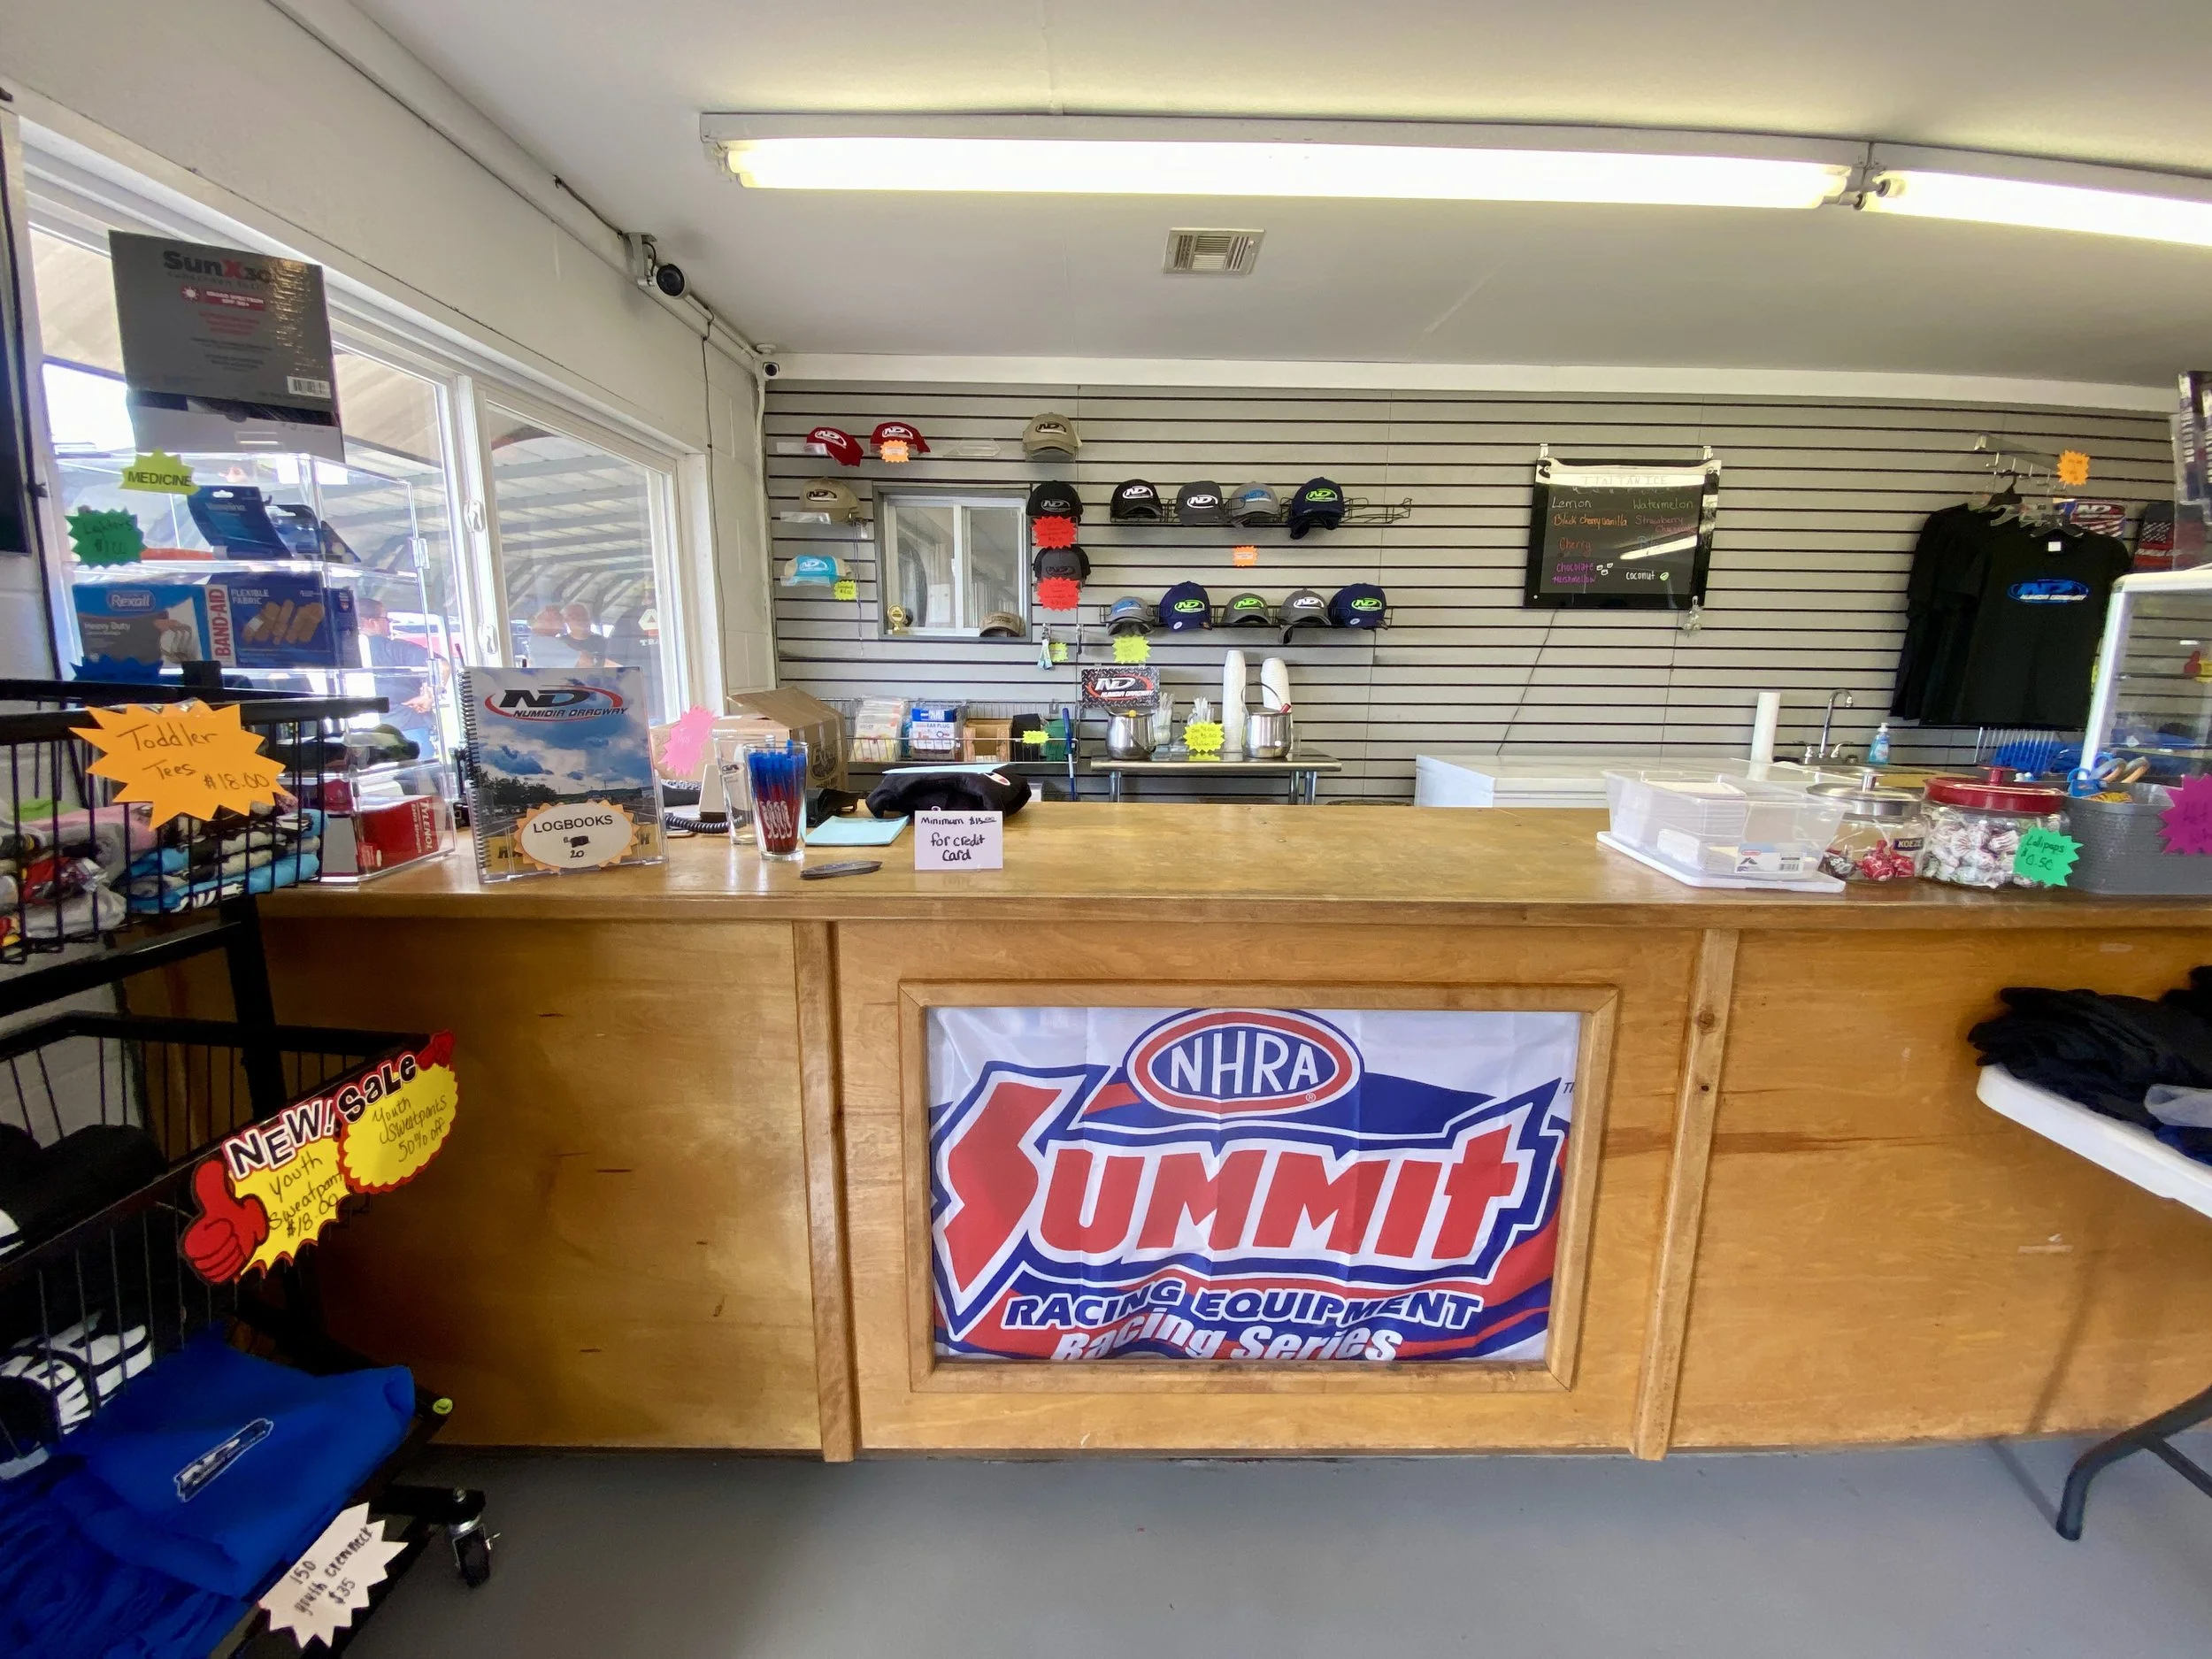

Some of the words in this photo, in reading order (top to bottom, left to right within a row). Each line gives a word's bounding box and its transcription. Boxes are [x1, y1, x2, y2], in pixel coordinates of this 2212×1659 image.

[127, 470, 191, 487] MEDICINE
[1551, 496, 1592, 509] Lemon
[1632, 498, 1694, 510] Watermelon
[111, 595, 150, 607] Rexall
[111, 622, 131, 631] Duty
[209, 588, 231, 657] BAND-AID
[499, 689, 591, 708] ND
[513, 709, 565, 718] NUMIDIA
[568, 707, 628, 717] DRAGWAY
[117, 722, 219, 750] Toddler
[142, 759, 196, 780] Tees
[419, 800, 434, 851] TYLENOL
[533, 815, 613, 833] LOGBOOKS
[921, 817, 964, 826] Minimum
[954, 833, 985, 847] credit
[1169, 1028, 1319, 1095] NHRA
[225, 1100, 336, 1180] NEW!
[398, 1133, 428, 1163] 50%
[1005, 1279, 1183, 1327] RACING
[1197, 1290, 1484, 1331] EQUIPMENT
[1051, 1306, 1221, 1363] Racing
[1234, 1320, 1402, 1363] Series
[327, 1578, 356, 1605] $35
